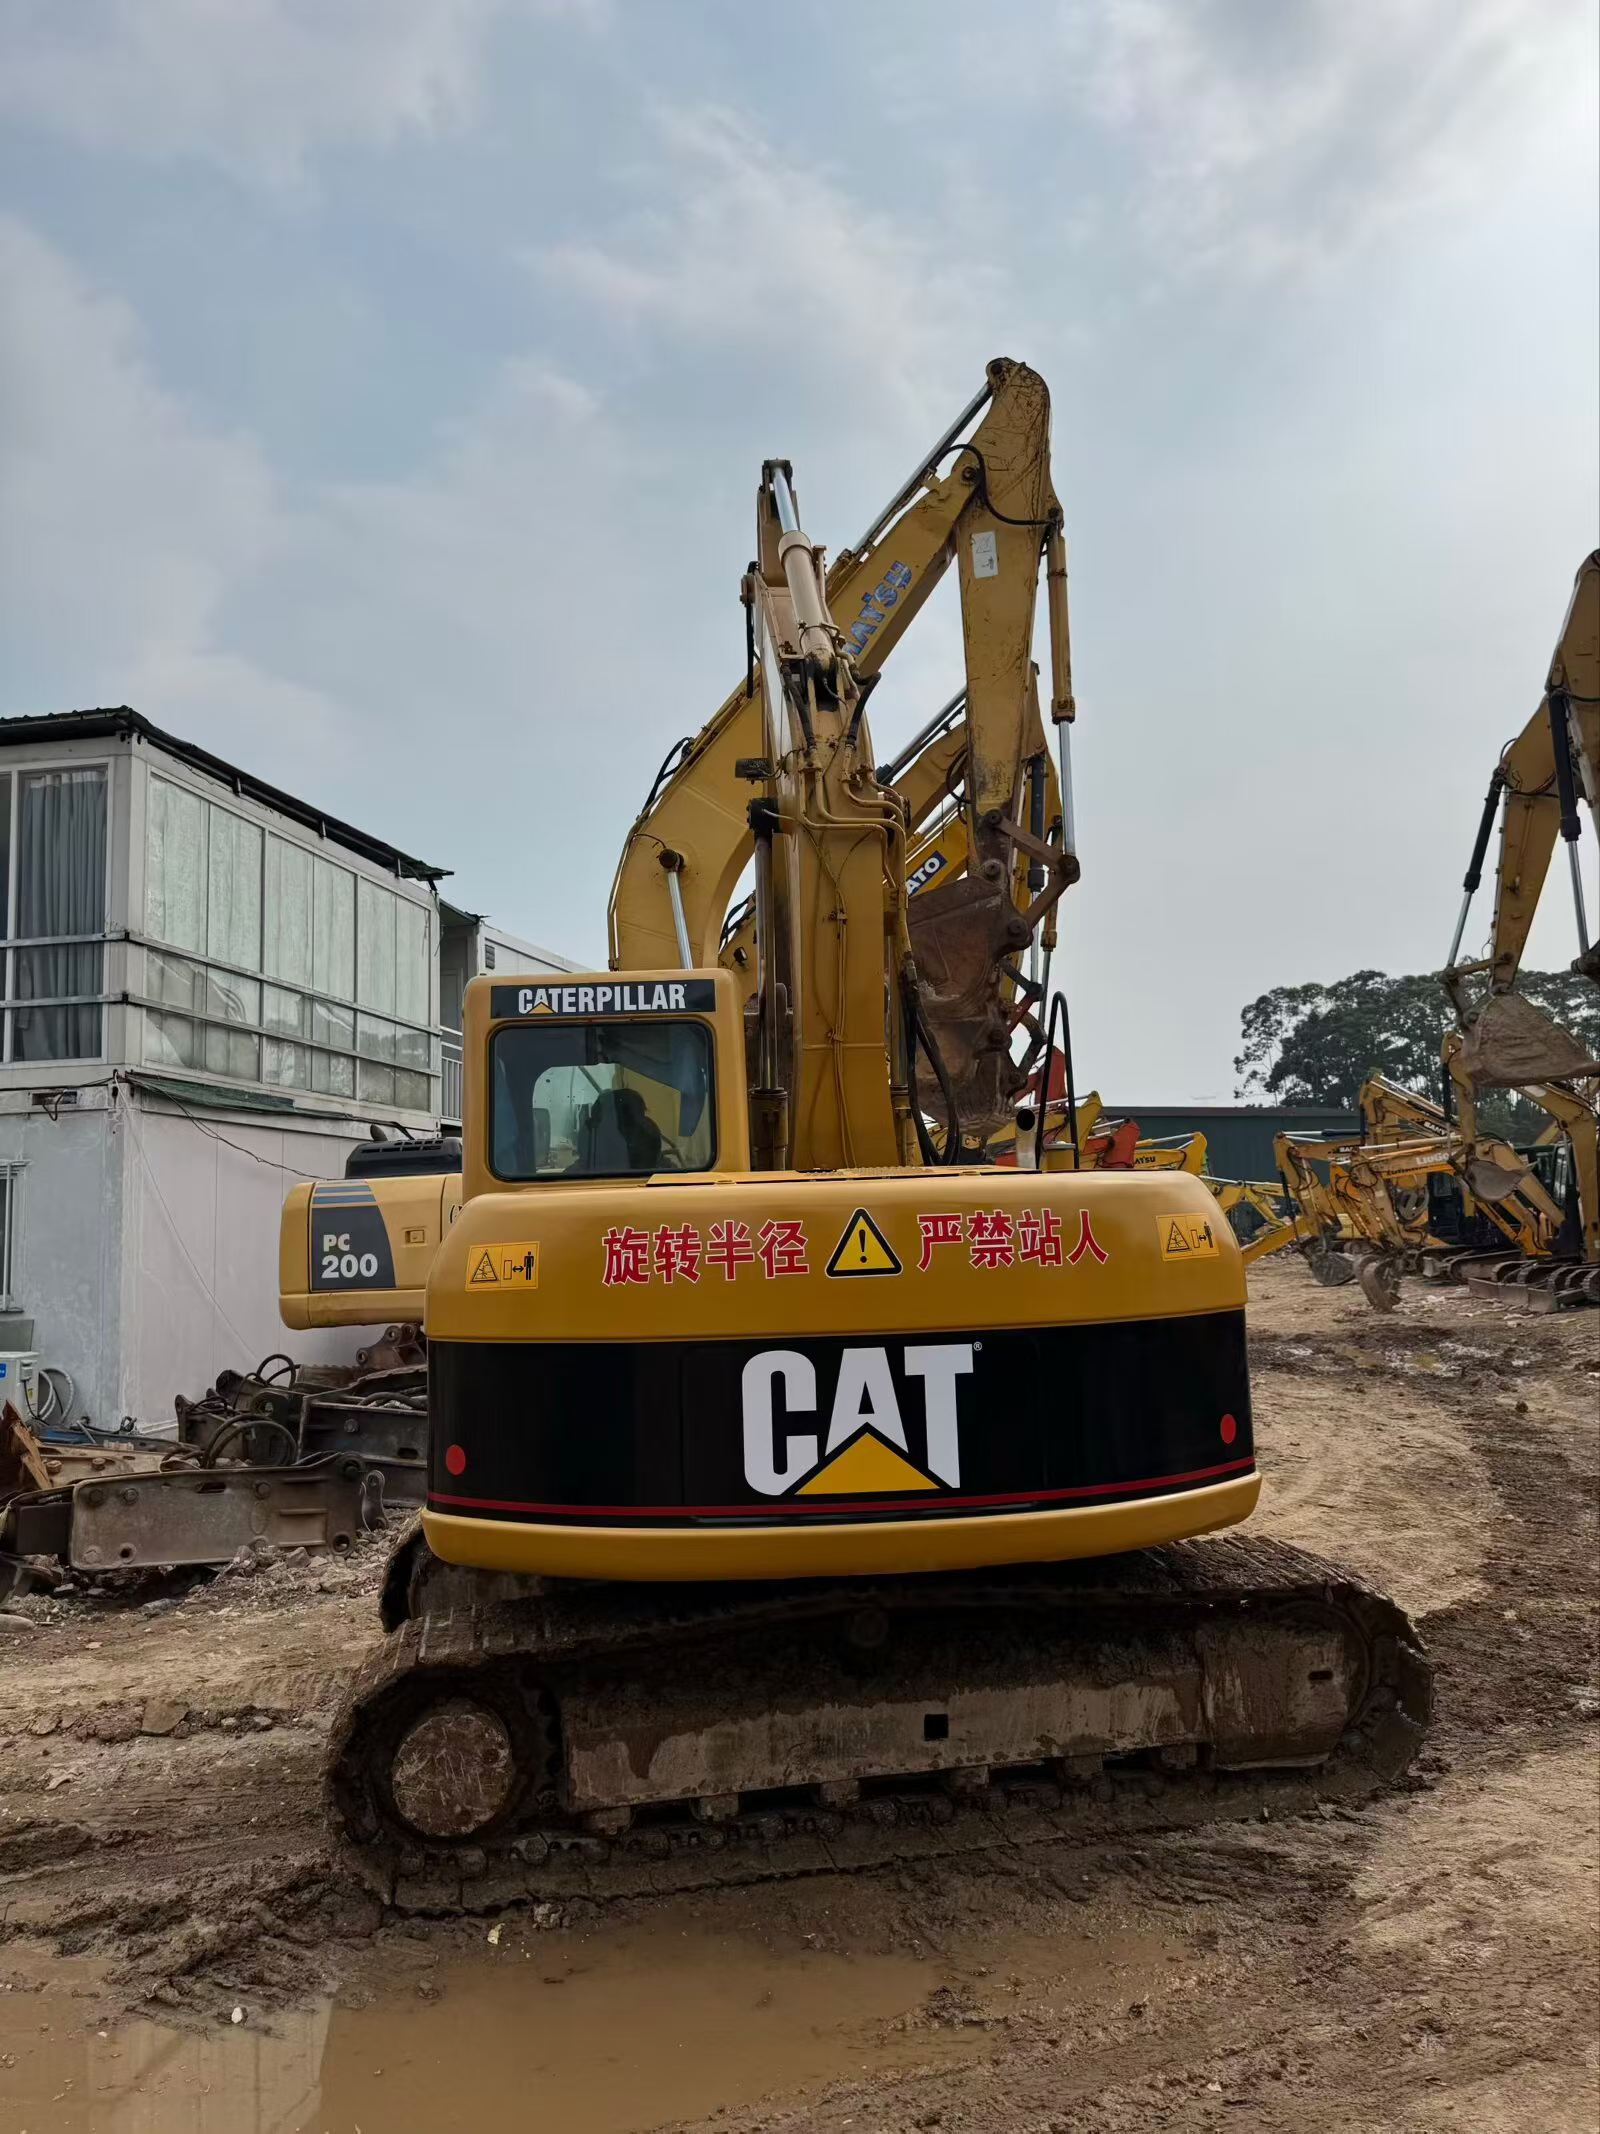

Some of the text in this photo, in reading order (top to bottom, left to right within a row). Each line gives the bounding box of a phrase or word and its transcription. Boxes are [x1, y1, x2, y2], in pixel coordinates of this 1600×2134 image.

[518, 983, 687, 1015] CATERPILLAR
[323, 1233, 351, 1252] PC
[602, 1208, 1109, 1287] 旋转半径 严禁站人
[321, 1253, 379, 1279] 200
